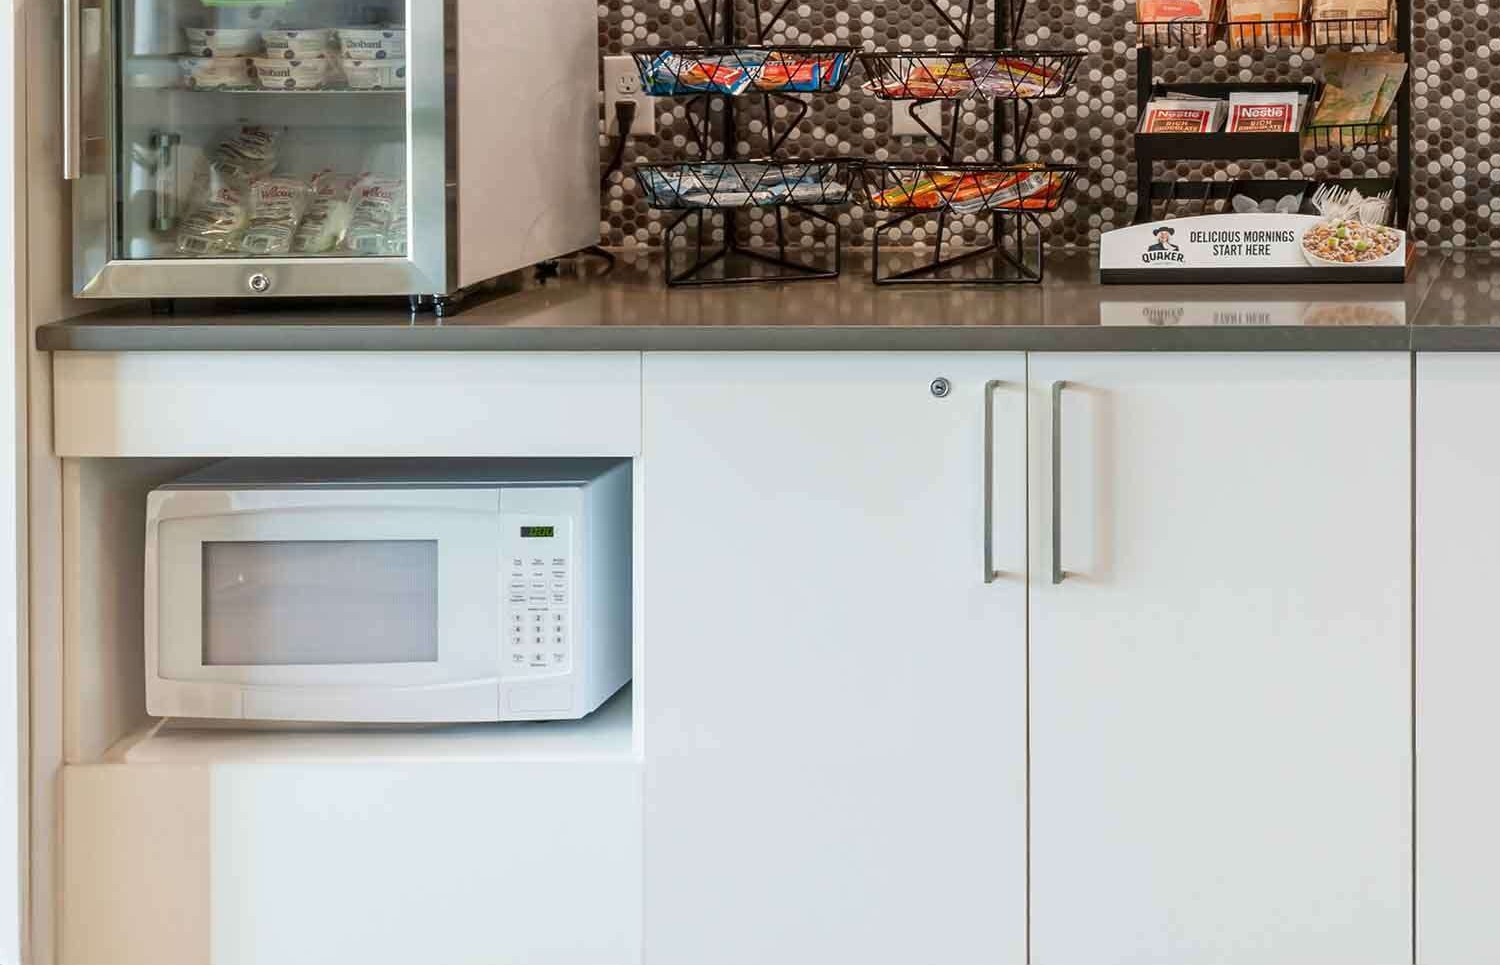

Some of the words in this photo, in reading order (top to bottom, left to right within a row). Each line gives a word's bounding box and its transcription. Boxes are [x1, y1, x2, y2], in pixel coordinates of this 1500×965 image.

[1190, 231, 1241, 243] DELICIOUS
[1243, 230, 1295, 243] MORNINGS
[1212, 244, 1243, 256] START
[1245, 244, 1271, 256] HERE
[1142, 251, 1185, 264] QUAKER
